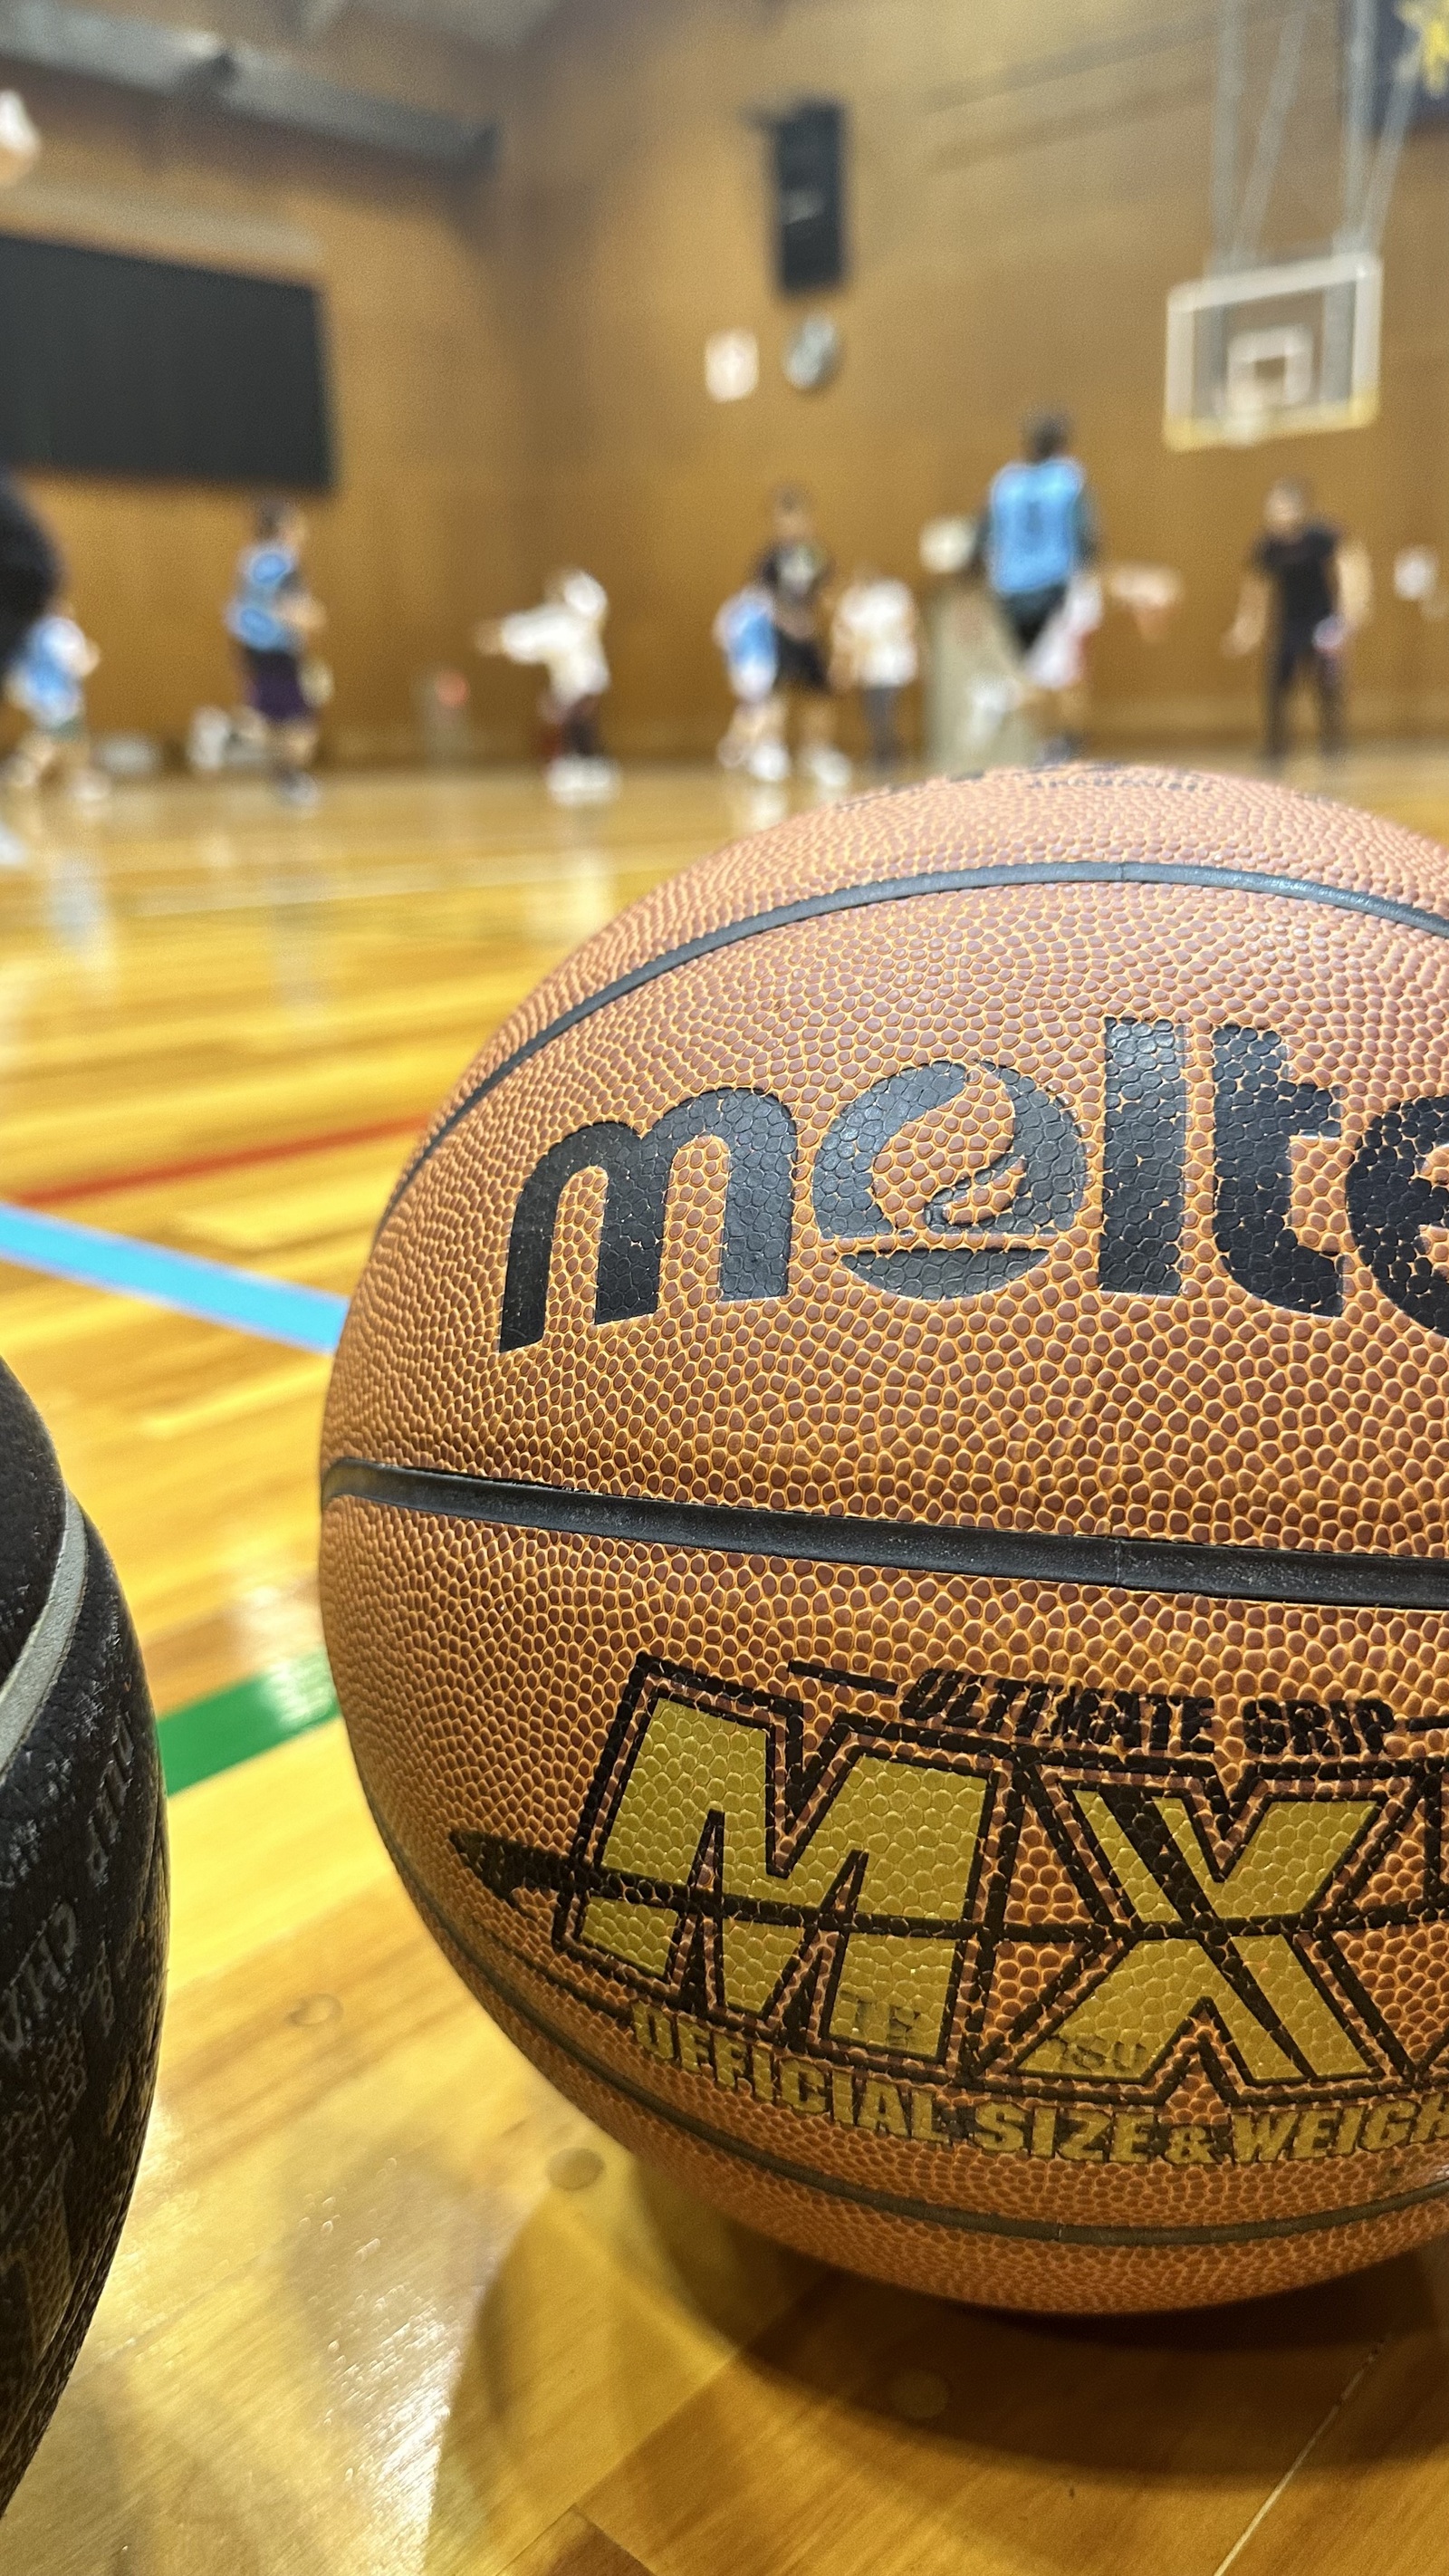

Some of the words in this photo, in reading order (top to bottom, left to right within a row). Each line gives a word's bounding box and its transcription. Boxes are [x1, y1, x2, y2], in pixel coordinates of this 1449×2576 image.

[899, 1667, 1215, 1754] ULTIMATE
[1241, 1697, 1396, 1755] GRIP
[632, 1998, 951, 2145] OFFICIAL
[972, 2100, 1156, 2165] SIZE
